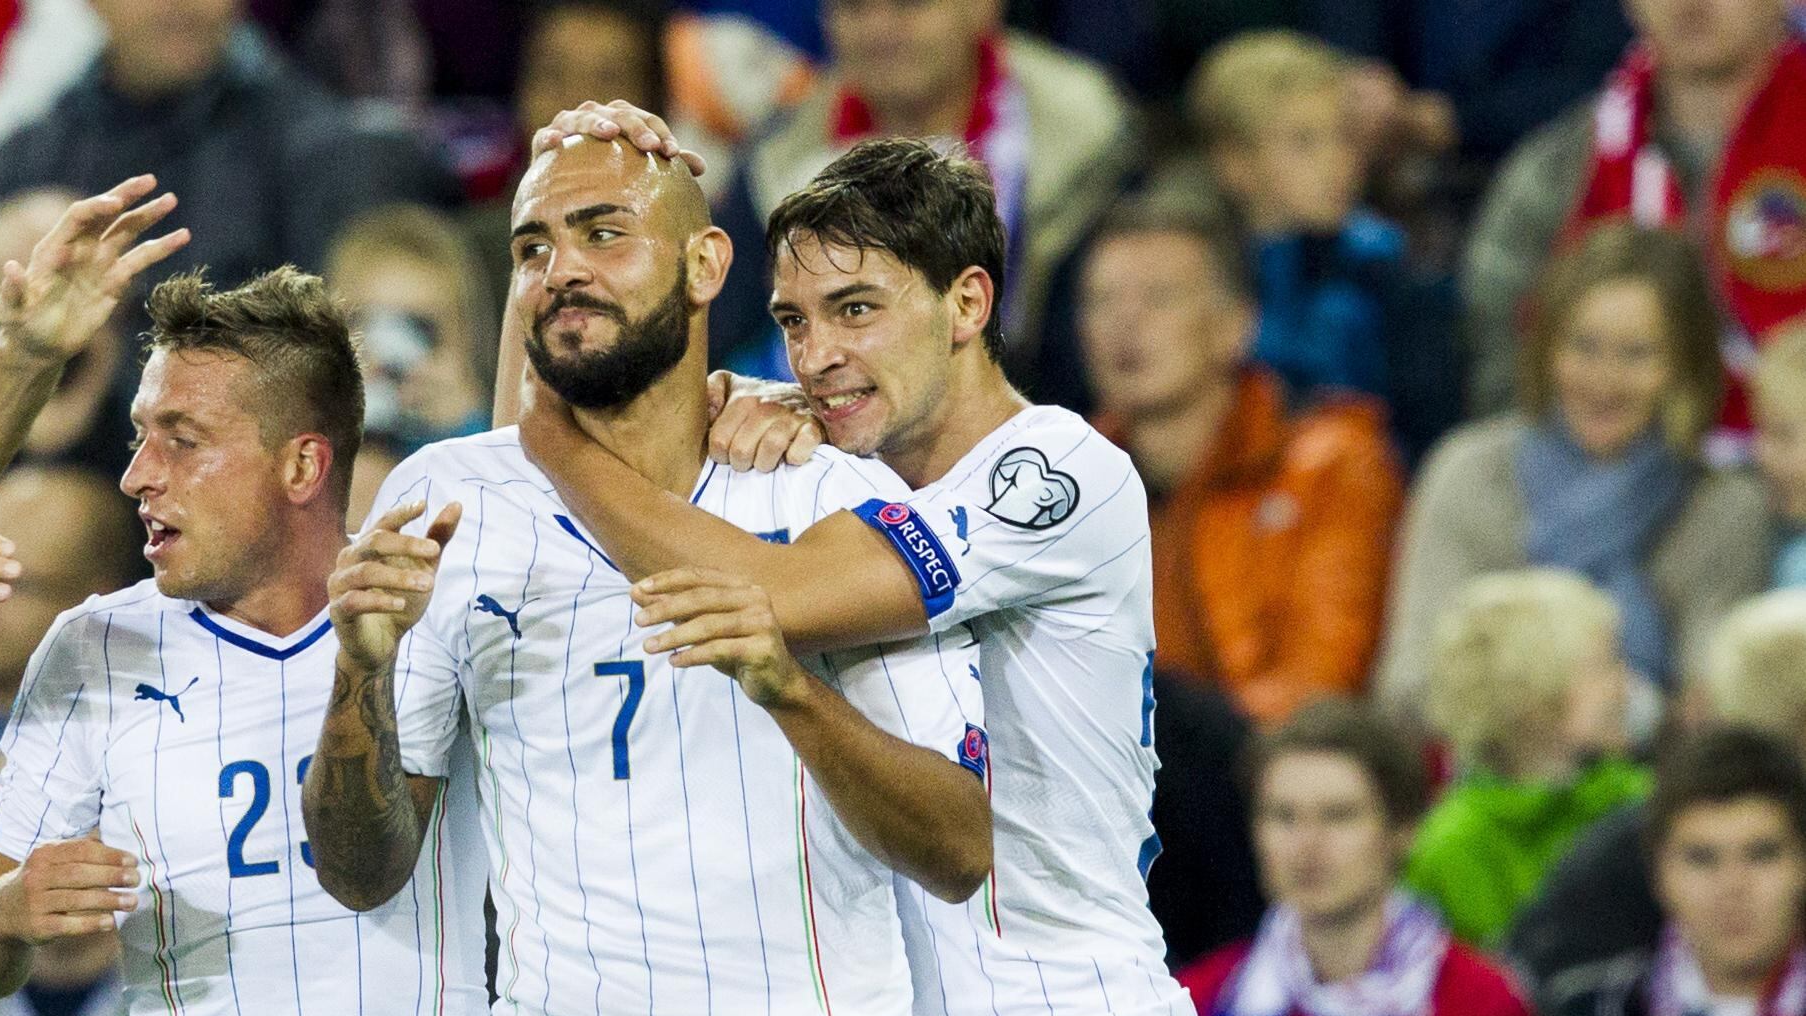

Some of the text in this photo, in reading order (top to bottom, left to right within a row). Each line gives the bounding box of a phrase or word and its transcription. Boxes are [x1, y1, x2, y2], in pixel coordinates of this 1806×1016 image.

[898, 521, 952, 592] RESPECT
[594, 661, 646, 780] 7
[217, 754, 316, 878] 2
